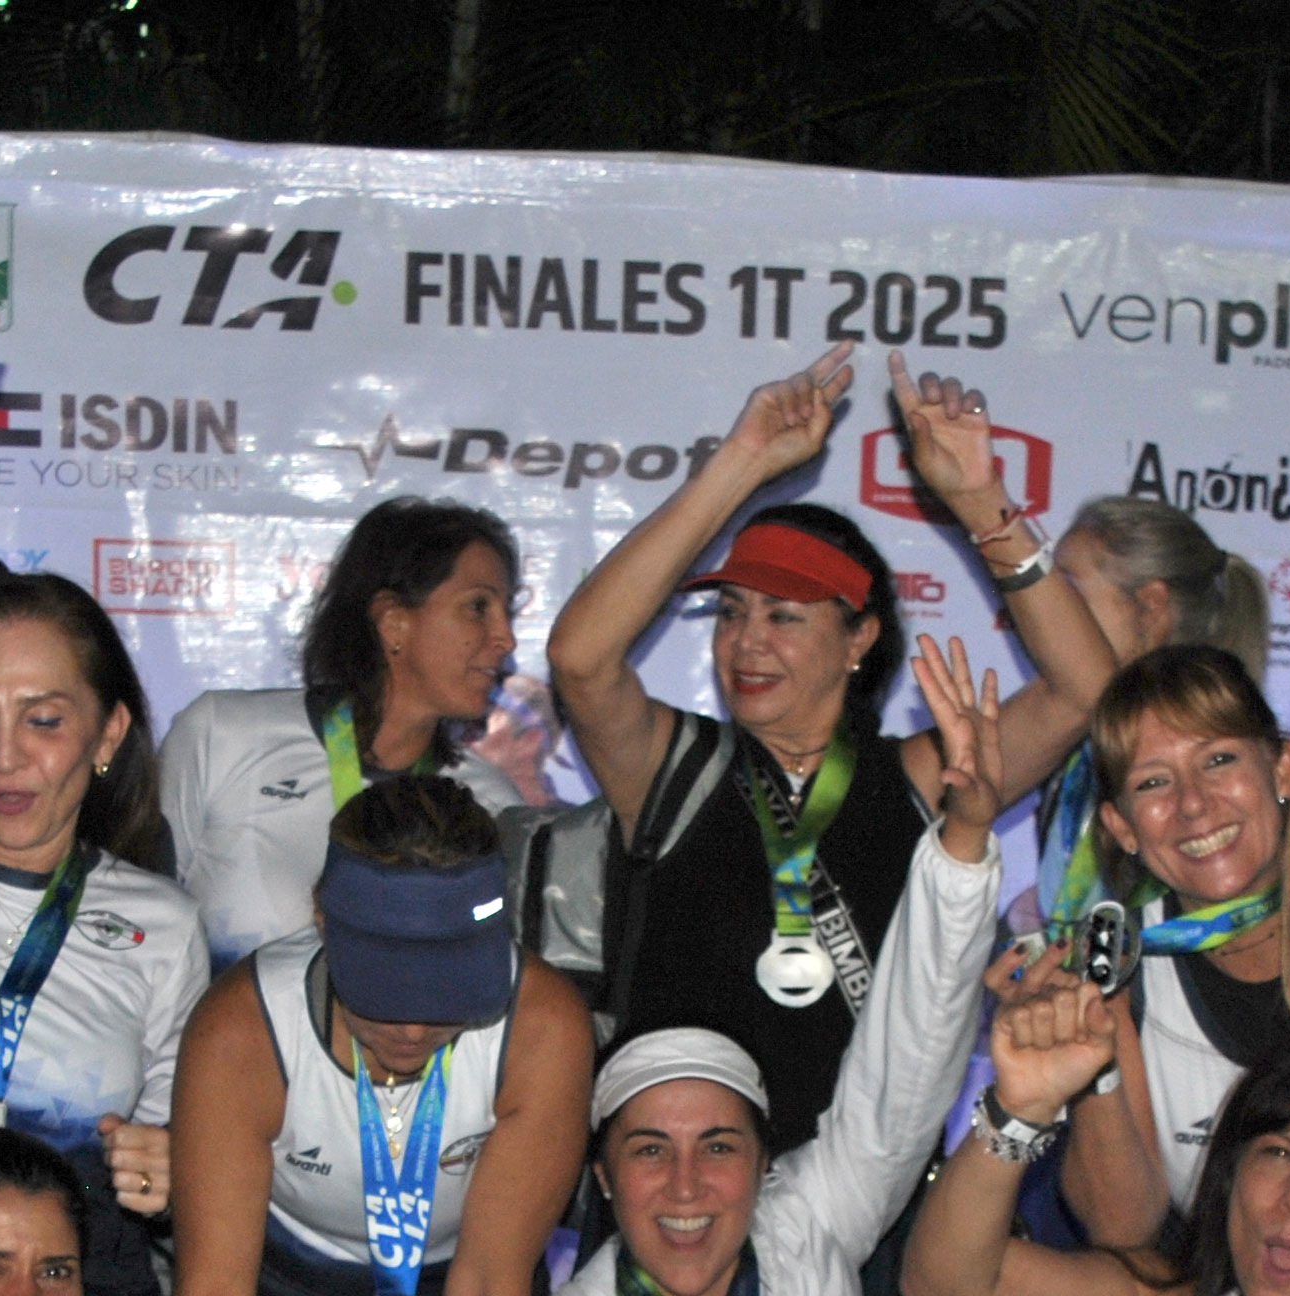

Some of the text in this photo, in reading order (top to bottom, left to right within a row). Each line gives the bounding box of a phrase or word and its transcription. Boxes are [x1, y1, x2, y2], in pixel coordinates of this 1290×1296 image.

[404, 251, 707, 336] FINALES
[728, 264, 806, 339] 1T
[825, 268, 1008, 350] 2025
[59, 393, 239, 454] ISDIN
[30, 459, 139, 489] YOUR
[151, 463, 241, 491] SKIN
